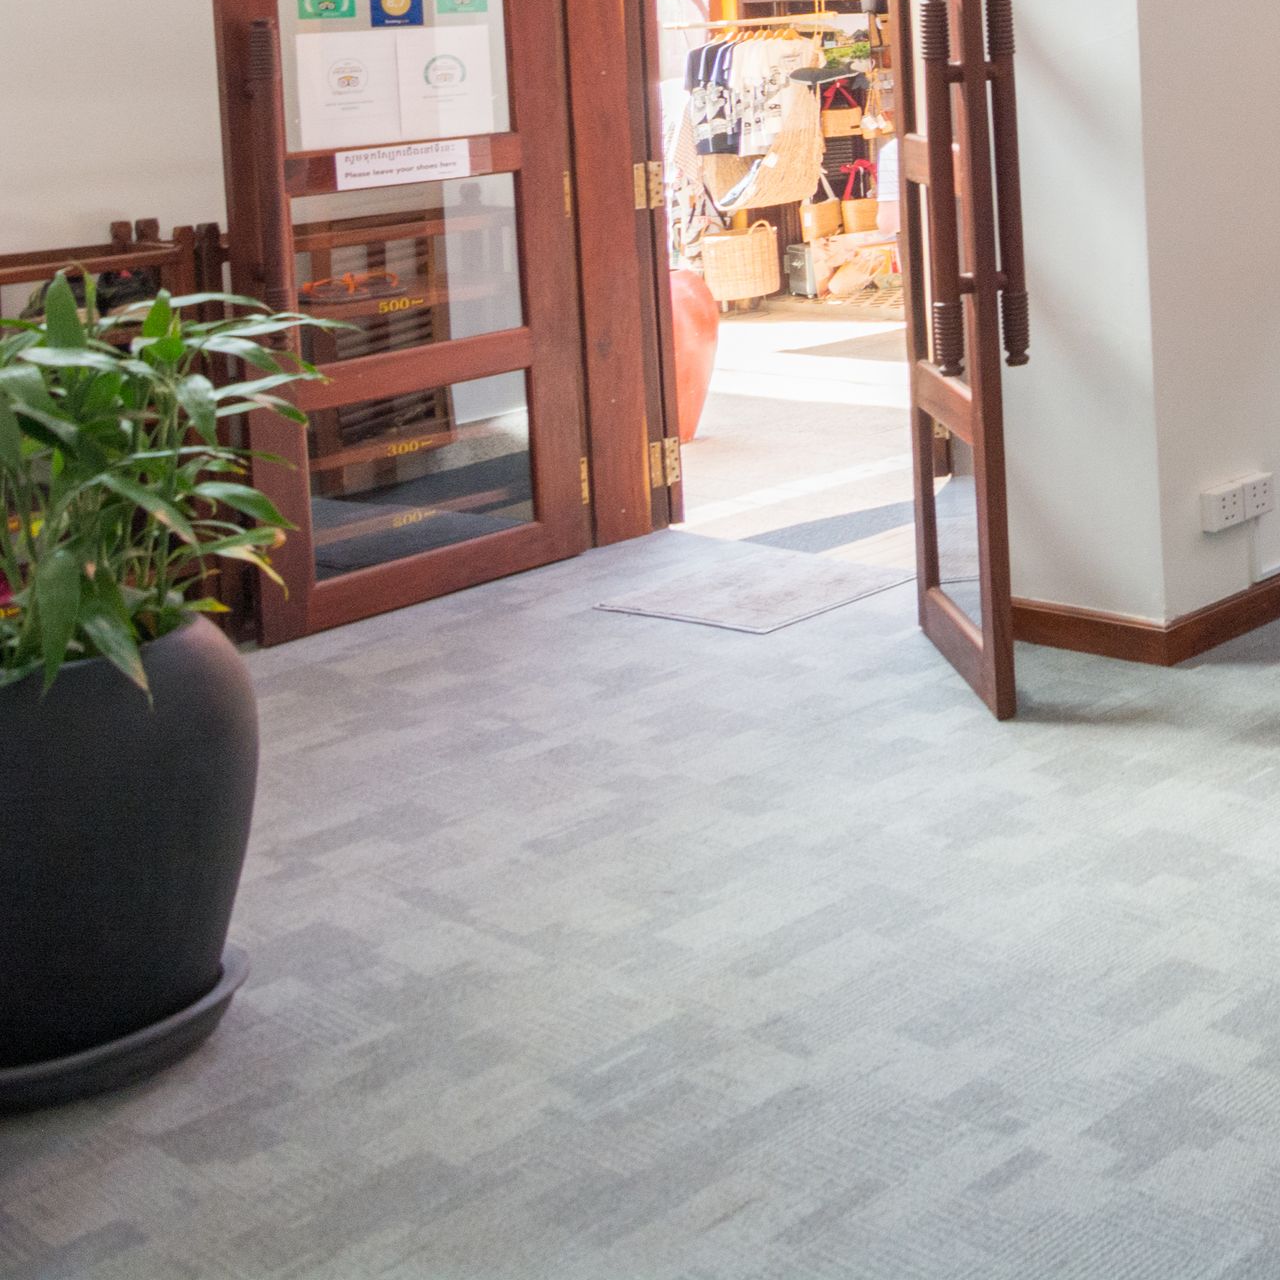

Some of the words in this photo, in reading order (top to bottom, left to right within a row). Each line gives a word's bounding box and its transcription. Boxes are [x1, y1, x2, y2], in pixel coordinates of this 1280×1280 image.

[344, 170, 371, 179] Please
[373, 168, 394, 176] leave
[396, 166, 414, 175] your
[416, 163, 438, 171] shoes
[440, 160, 457, 168] here
